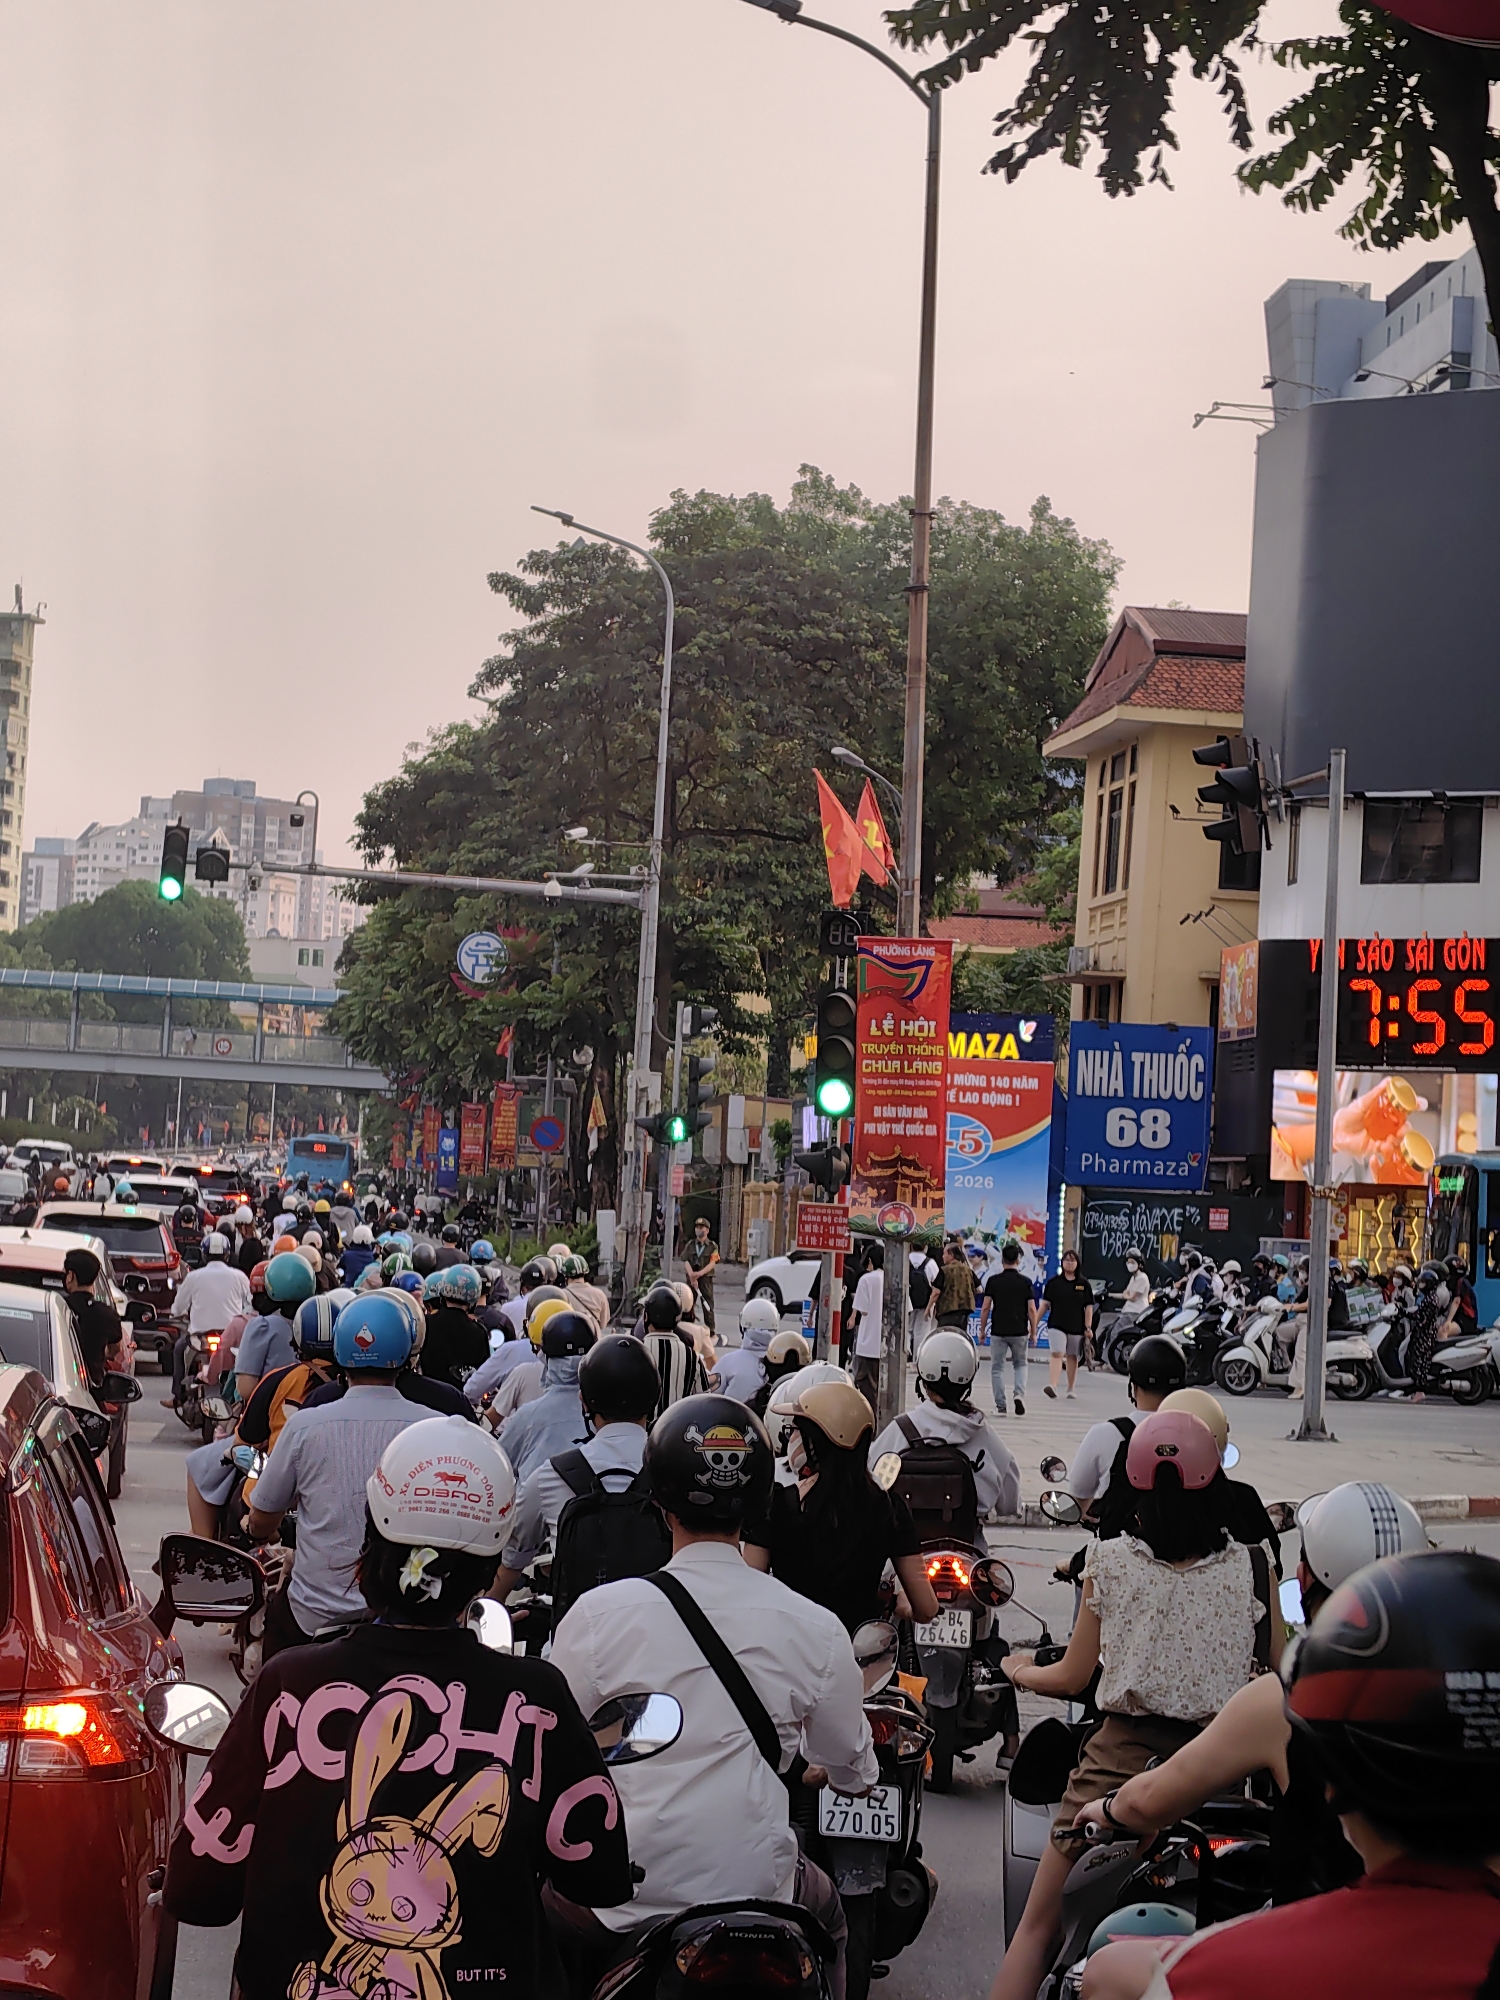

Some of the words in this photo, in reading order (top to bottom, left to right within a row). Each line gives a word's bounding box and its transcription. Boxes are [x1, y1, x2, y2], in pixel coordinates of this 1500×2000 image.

[873, 943, 911, 956] PHƯỜNG
[912, 943, 935, 956] LÁNG
[1309, 938, 1346, 973] YN
[1350, 979, 1494, 1054] 7:55
[870, 1012, 894, 1036] LỄ
[900, 1016, 937, 1041] HỘI
[907, 1041, 944, 1057] THỐNG
[862, 1056, 901, 1073] CHÙA
[904, 1057, 942, 1074] LÁNG
[1076, 1041, 1124, 1098] NHÀ
[1131, 1038, 1205, 1101] THUỐC
[954, 1071, 987, 1088] MỪNG
[990, 1076, 1010, 1089] 140
[1012, 1075, 1038, 1090] NĂM
[959, 1091, 979, 1104] LAO
[982, 1091, 1012, 1107] ĐỘNG
[873, 1105, 881, 1117] DI
[882, 1103, 896, 1118] SẢN
[897, 1104, 912, 1119] VĂN
[863, 1123, 876, 1134] PHI
[877, 1121, 891, 1137] VẬT
[905, 1121, 924, 1137] QUỐC
[1106, 1107, 1171, 1149] 68
[1081, 1153, 1189, 1177] Pharmaza
[954, 1175, 994, 1189] 2026
[399, 1480, 411, 1497] XE
[408, 1458, 434, 1480] ĐIỆN
[436, 1455, 481, 1476] PHƯƠNG
[480, 1476, 494, 1508] ĐÔNG
[414, 1487, 482, 1504] DIBAO
[825, 1810, 895, 1837] 270.05
[456, 1969, 481, 1982] BUT
[485, 1968, 507, 1980] IT'S
